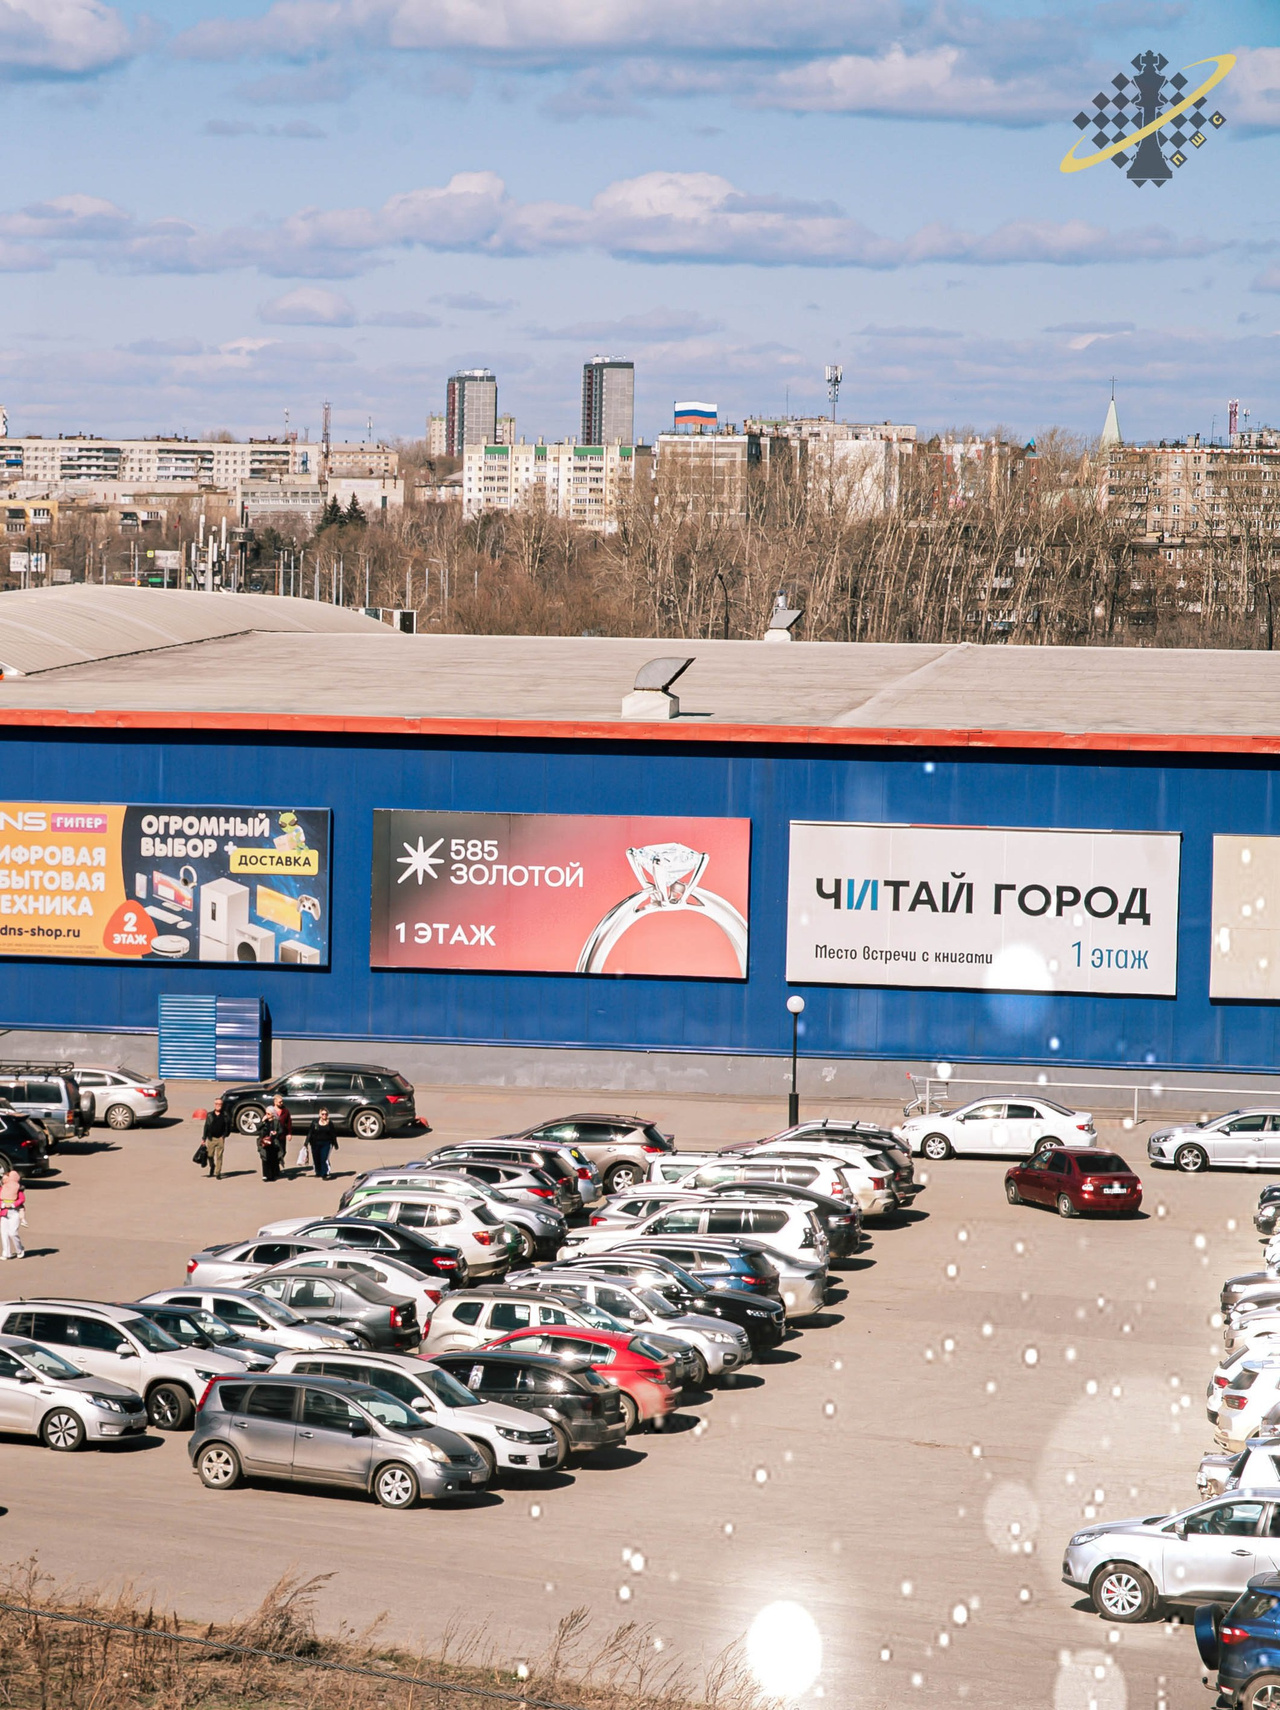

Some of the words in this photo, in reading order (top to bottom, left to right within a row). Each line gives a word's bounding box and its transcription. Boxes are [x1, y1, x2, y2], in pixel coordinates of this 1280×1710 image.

[56, 816, 104, 829] ГИПЕР
[141, 813, 270, 838] ОГРОМНЫЙ
[140, 837, 218, 859] ВЫБОР
[450, 839, 499, 862] 585
[238, 855, 312, 867] ДОСТАВКА
[450, 861, 584, 888] ЗОЛОТОЙ
[816, 871, 974, 914] ЧИТАЙ
[994, 884, 1151, 926] ГОРОД
[0, 925, 81, 940] dns-shop.ru
[123, 912, 138, 932] 2
[112, 933, 147, 945] ЭТАЖ
[395, 922, 406, 943] 1
[414, 922, 496, 946] ЭТАЖ
[815, 944, 857, 960] Место
[863, 945, 916, 964] встречи
[921, 952, 929, 962] с
[934, 951, 993, 964] книгами
[1071, 940, 1082, 967] 1
[1091, 948, 1149, 969] этаж
